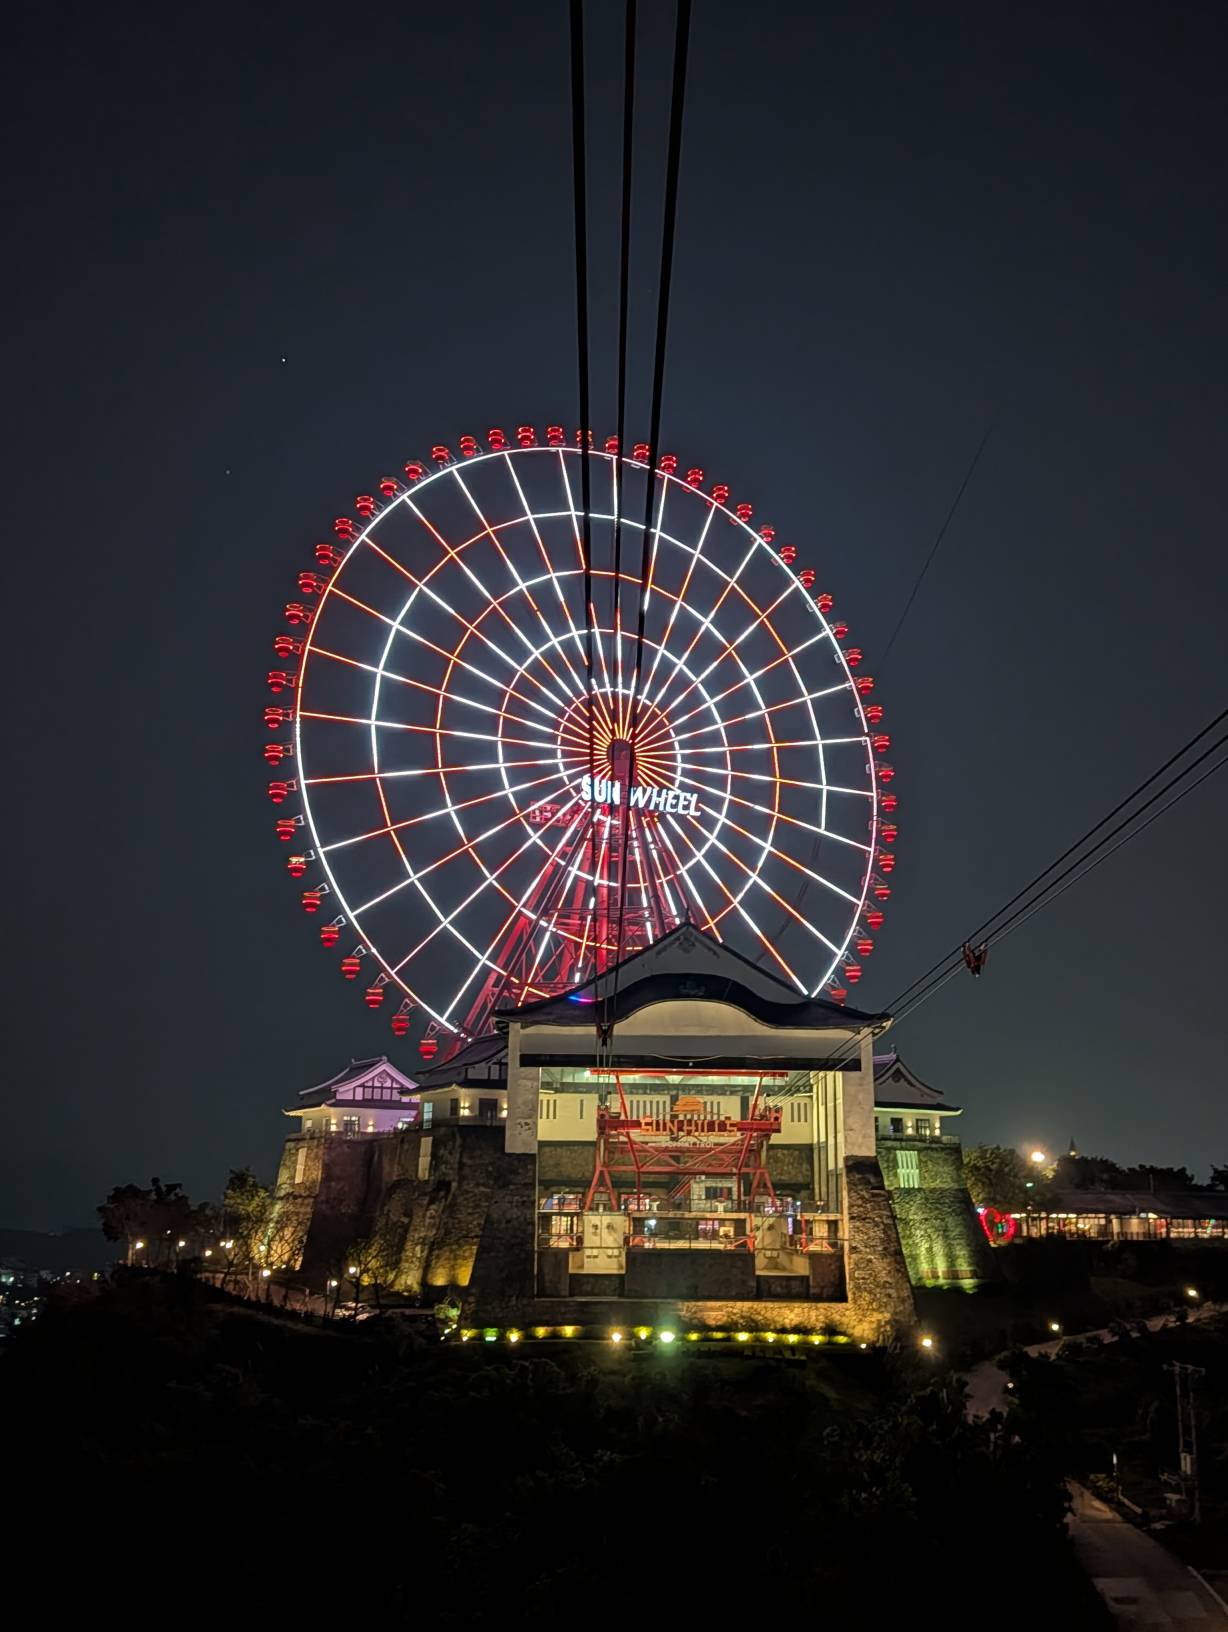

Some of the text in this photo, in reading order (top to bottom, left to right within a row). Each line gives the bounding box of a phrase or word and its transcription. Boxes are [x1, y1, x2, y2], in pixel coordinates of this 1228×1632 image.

[581, 774, 702, 817] SUN WHEEL
[639, 1116, 738, 1137] SUN HILLS
